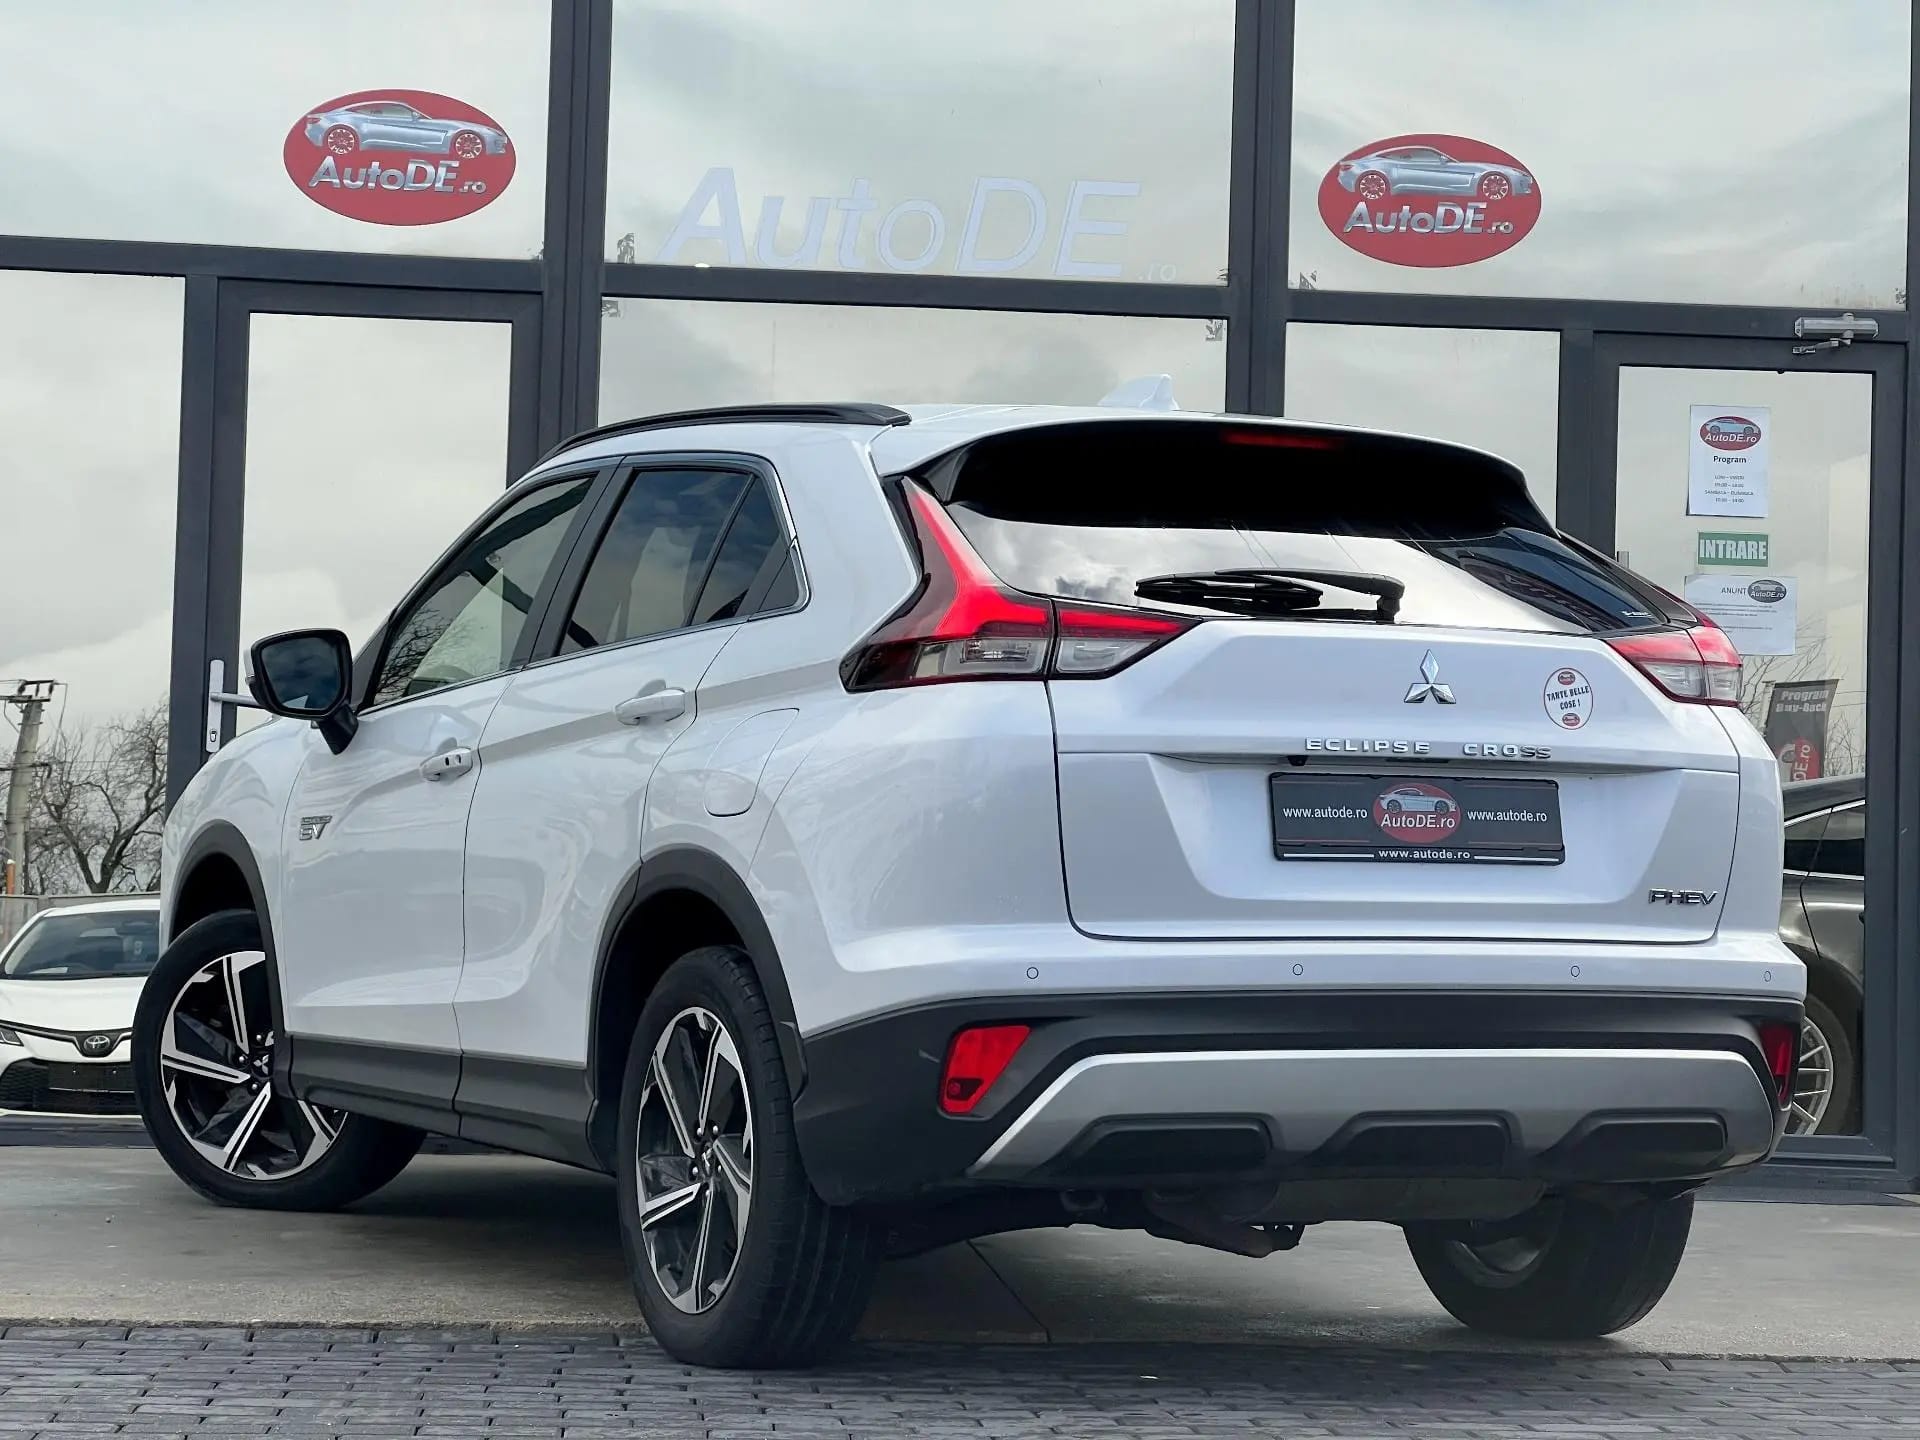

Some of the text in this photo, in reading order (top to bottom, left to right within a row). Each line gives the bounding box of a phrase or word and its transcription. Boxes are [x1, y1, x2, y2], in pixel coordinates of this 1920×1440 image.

[308, 155, 487, 194] AutoDE.ro
[1343, 201, 1514, 234] AutoDE.ro
[1704, 432, 1757, 443] AutoDE.ro
[1713, 455, 1747, 464] Program
[1699, 539, 1767, 560] INTRARE
[1569, 686, 1589, 697] BELLE
[1781, 689, 1829, 702] Program
[1560, 700, 1576, 710] COSE
[1775, 703, 1826, 713] Buy-Back
[1305, 737, 1552, 759] ECLIPSE CROSS
[1793, 744, 1811, 781] DE.ro
[1283, 806, 1368, 819] www.autode.ro
[1467, 809, 1547, 823] www.autode.ro
[1380, 813, 1456, 829] AutoDE.ro
[1378, 849, 1471, 860] www.autode.ro
[1648, 888, 1719, 905] PHEV
